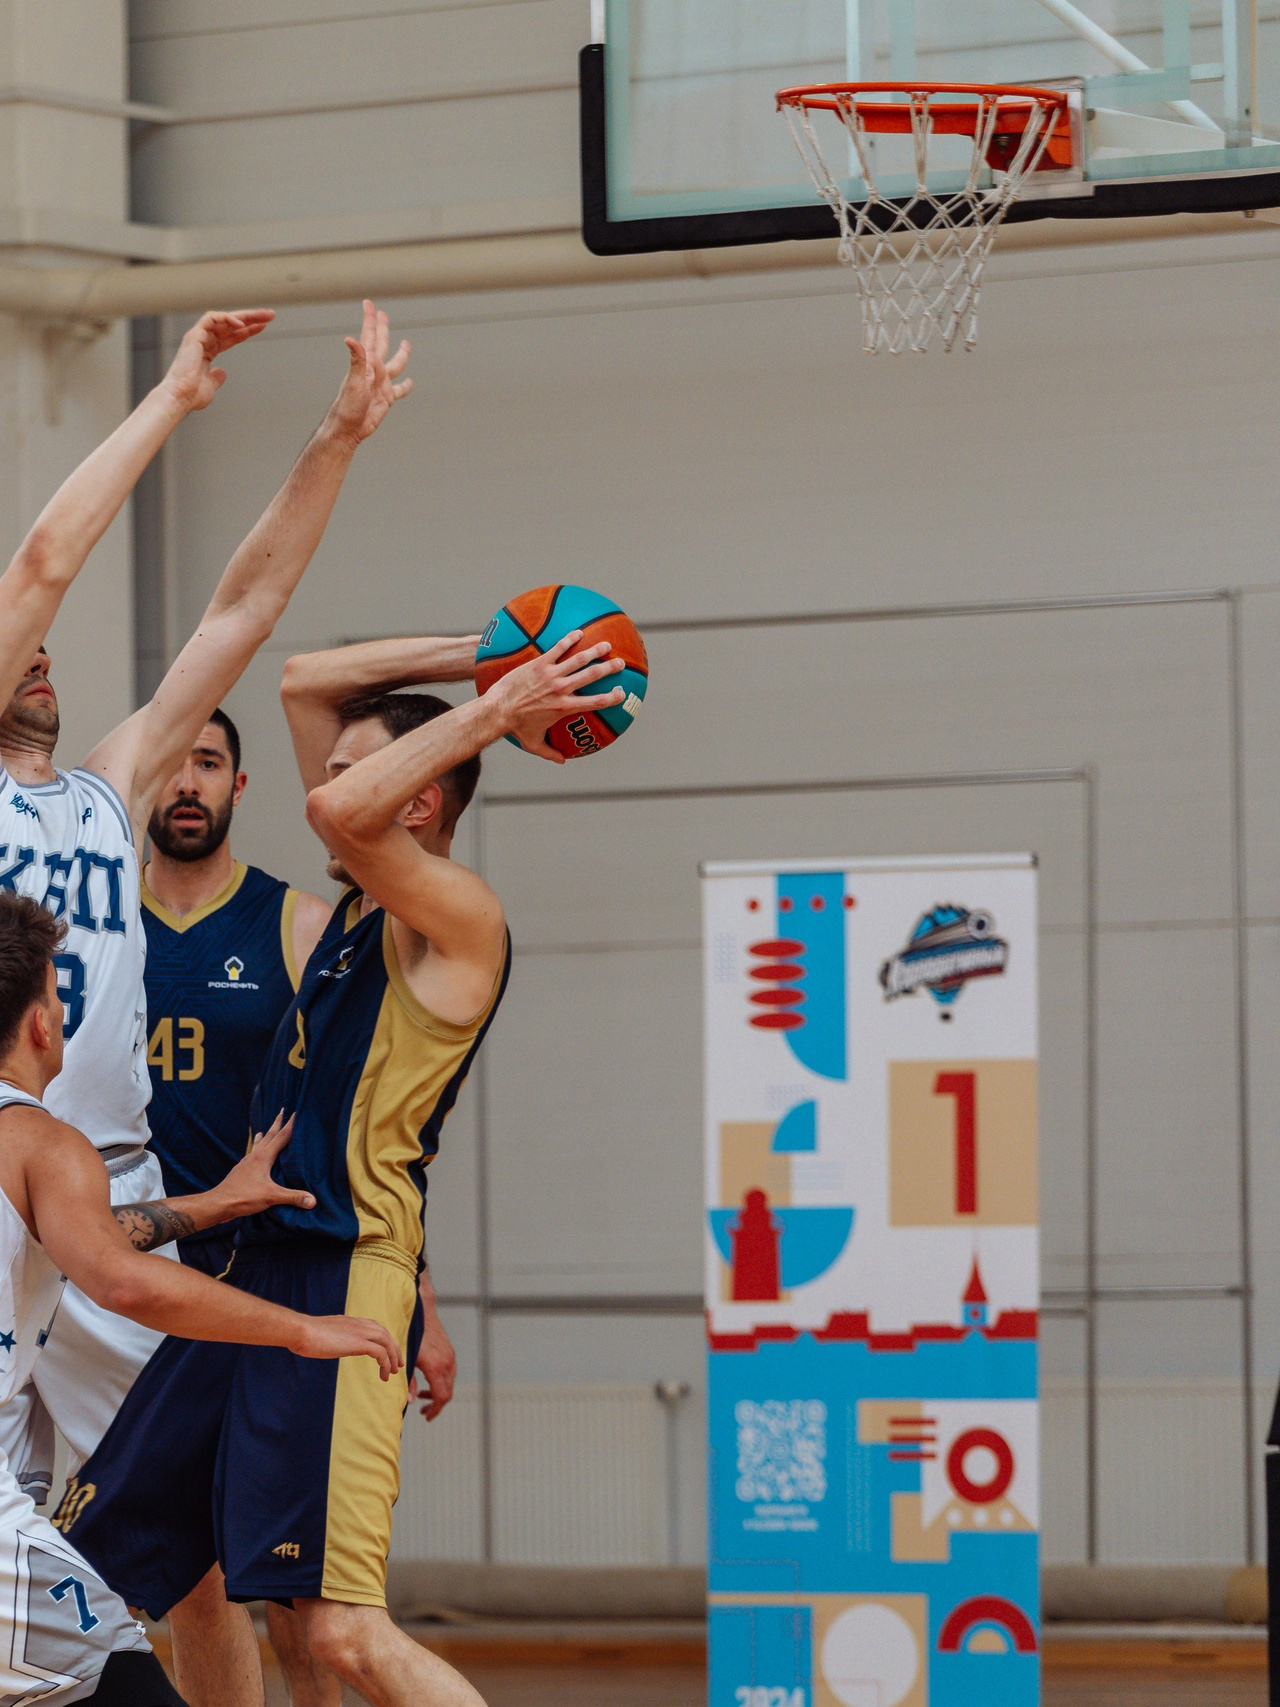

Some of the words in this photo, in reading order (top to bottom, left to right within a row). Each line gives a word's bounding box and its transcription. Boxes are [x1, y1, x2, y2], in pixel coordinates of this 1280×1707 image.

[208, 981, 260, 990] РОСНЕФТЬ
[147, 1016, 206, 1082] 43
[46, 1573, 102, 1636] 7
